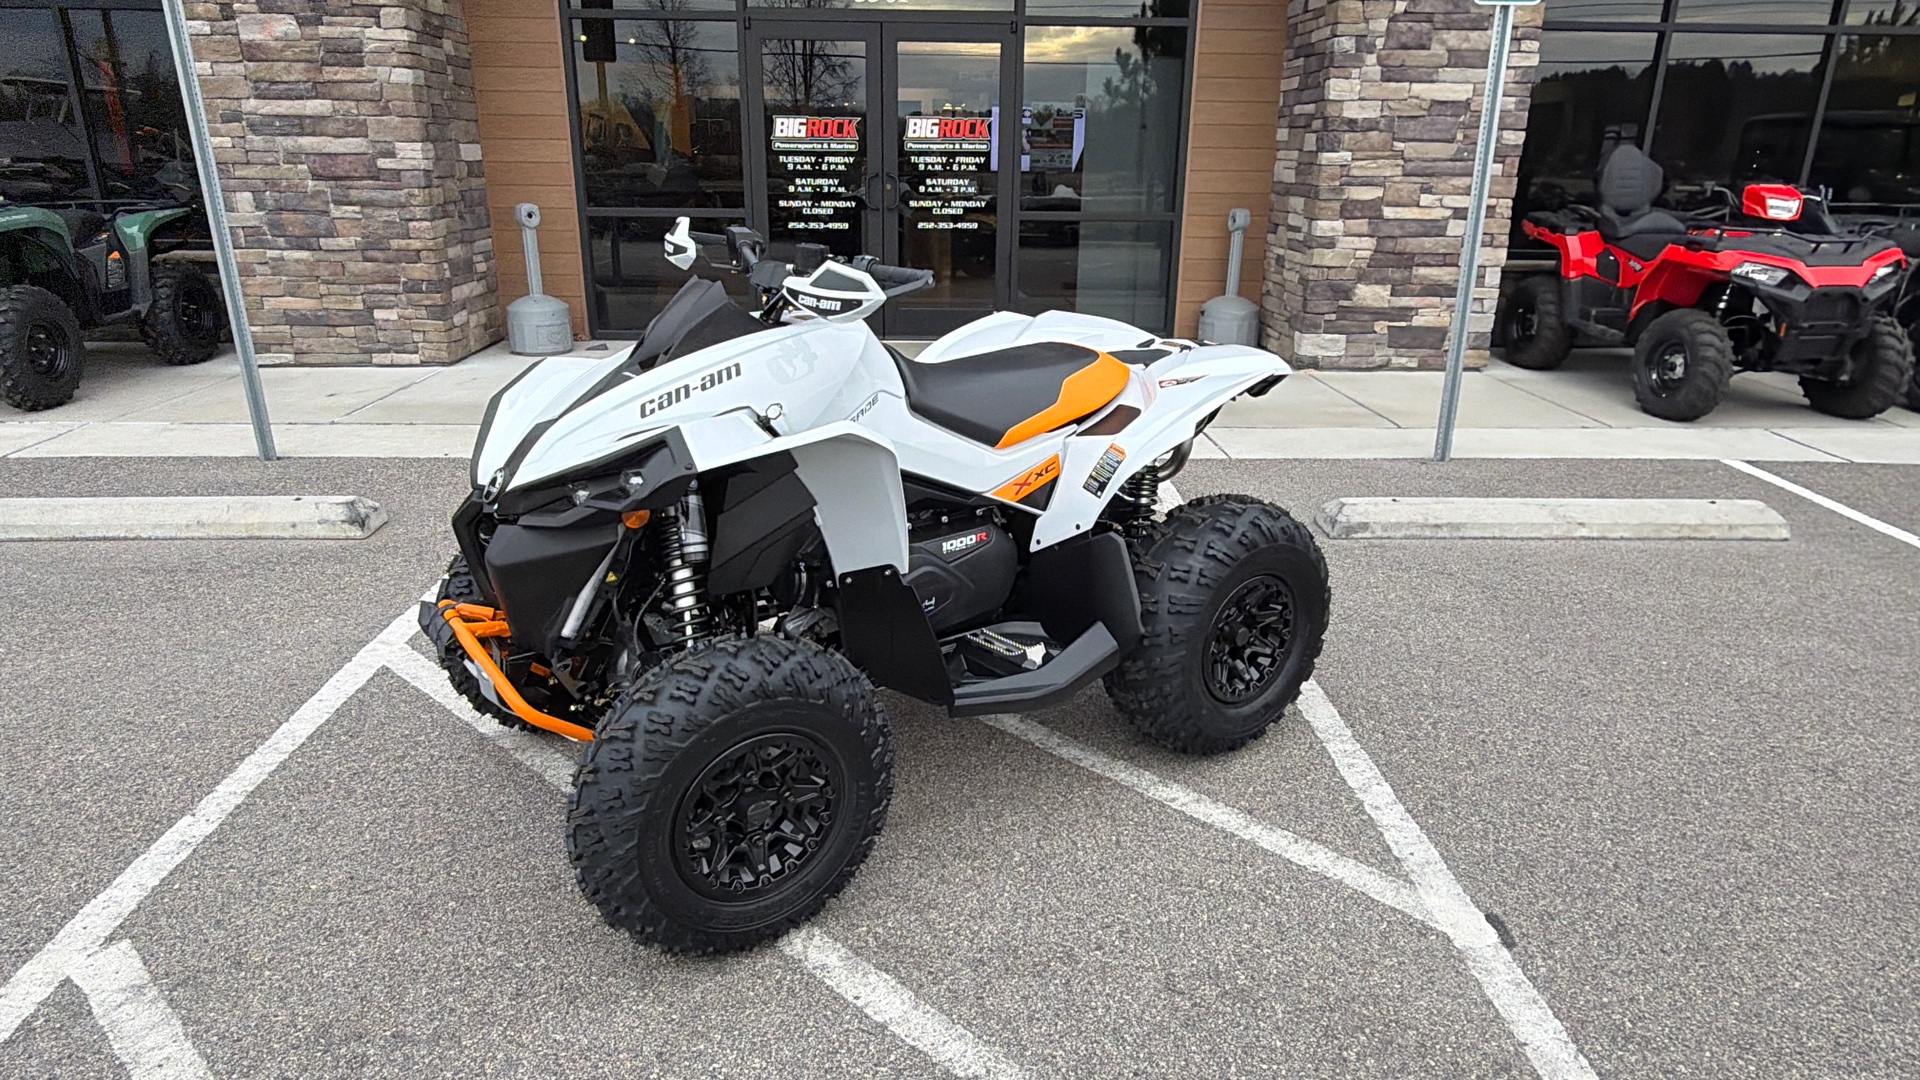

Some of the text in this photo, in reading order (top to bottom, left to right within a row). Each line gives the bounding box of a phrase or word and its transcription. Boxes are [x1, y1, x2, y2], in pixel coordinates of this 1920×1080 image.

[774, 142, 821, 150] Powersports
[907, 142, 953, 150] Powersports
[788, 185, 795, 193] 9
[919, 185, 925, 193] 9
[798, 294, 842, 311] can-am
[640, 362, 742, 419] can-am
[942, 532, 988, 552] 1000R
